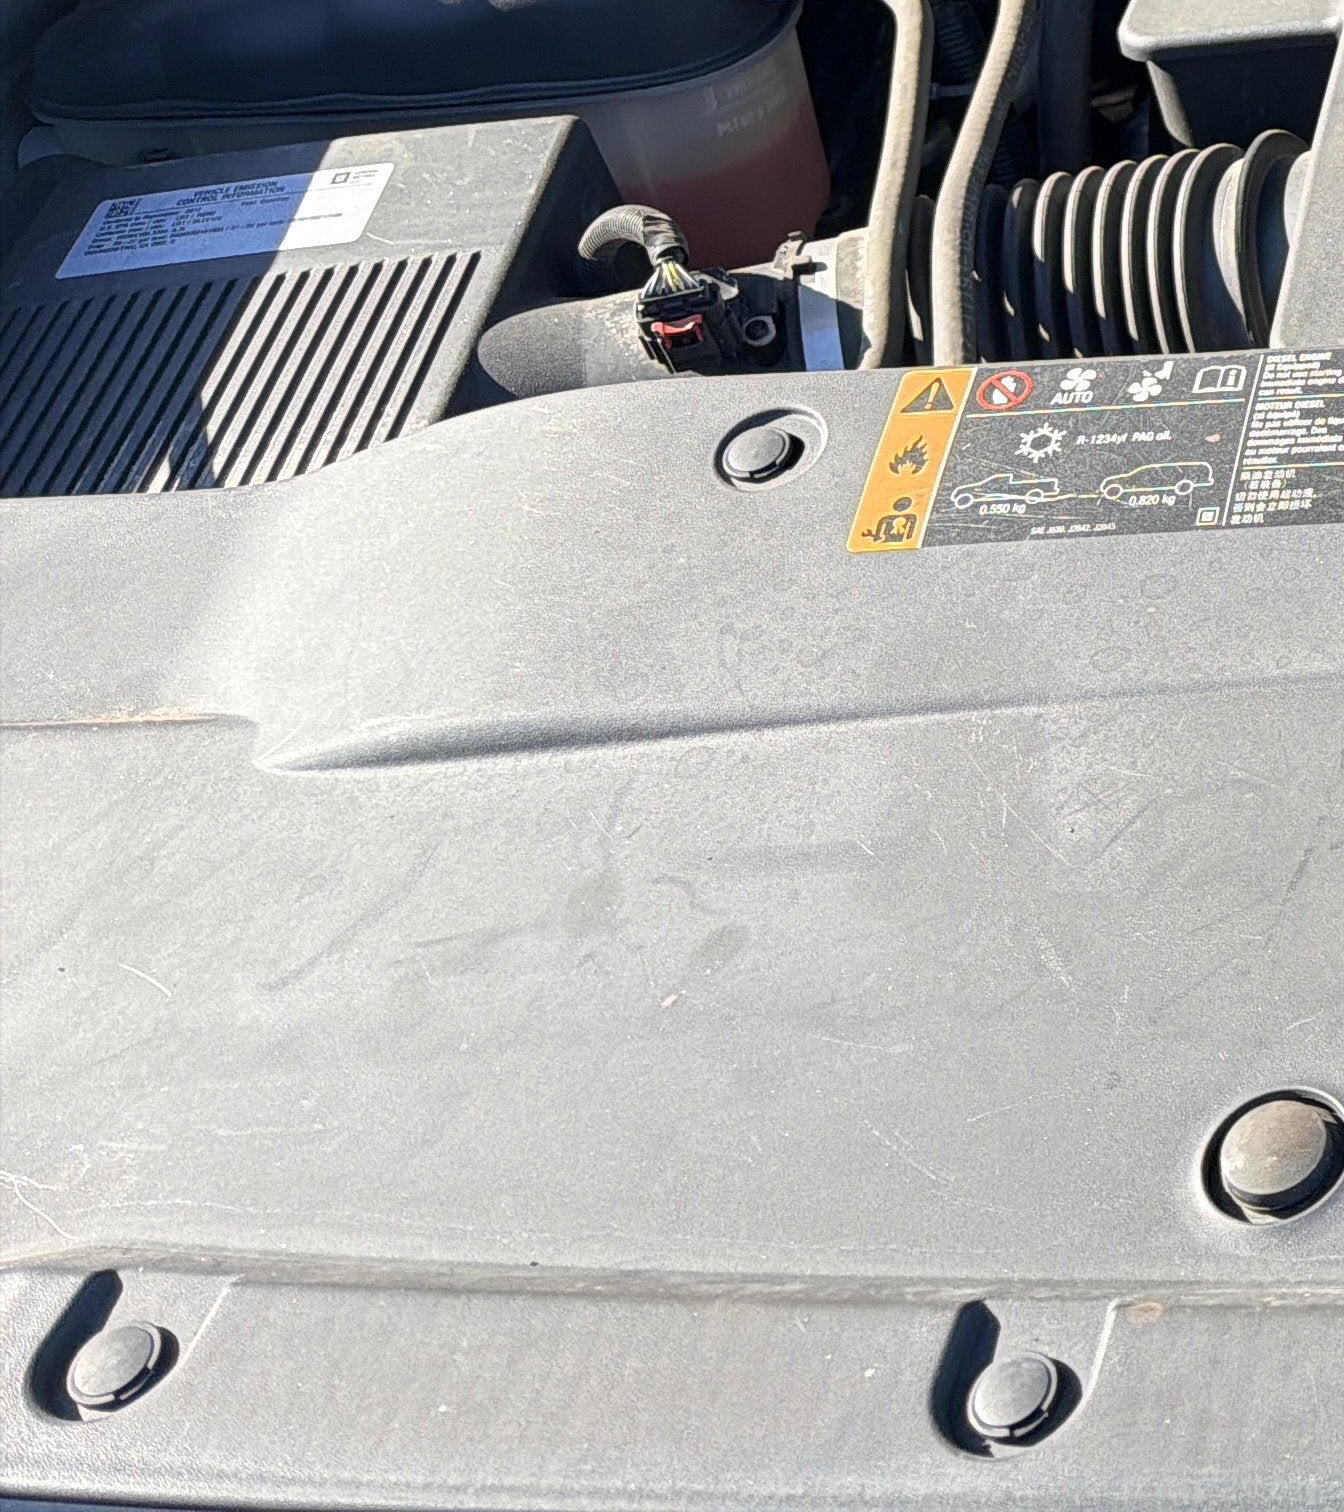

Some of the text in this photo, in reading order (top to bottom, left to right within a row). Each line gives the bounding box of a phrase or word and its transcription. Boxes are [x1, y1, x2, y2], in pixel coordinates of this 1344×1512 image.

[194, 180, 279, 198] VEHICLE EMISSION
[176, 186, 286, 207] CONTROL INFORMATION
[1050, 390, 1094, 405] AUTO
[1077, 432, 1128, 445] R-1234yf
[1132, 431, 1154, 442] PAG
[1129, 494, 1176, 507] 0.820 kg
[979, 503, 1026, 516] 0.550 kg
